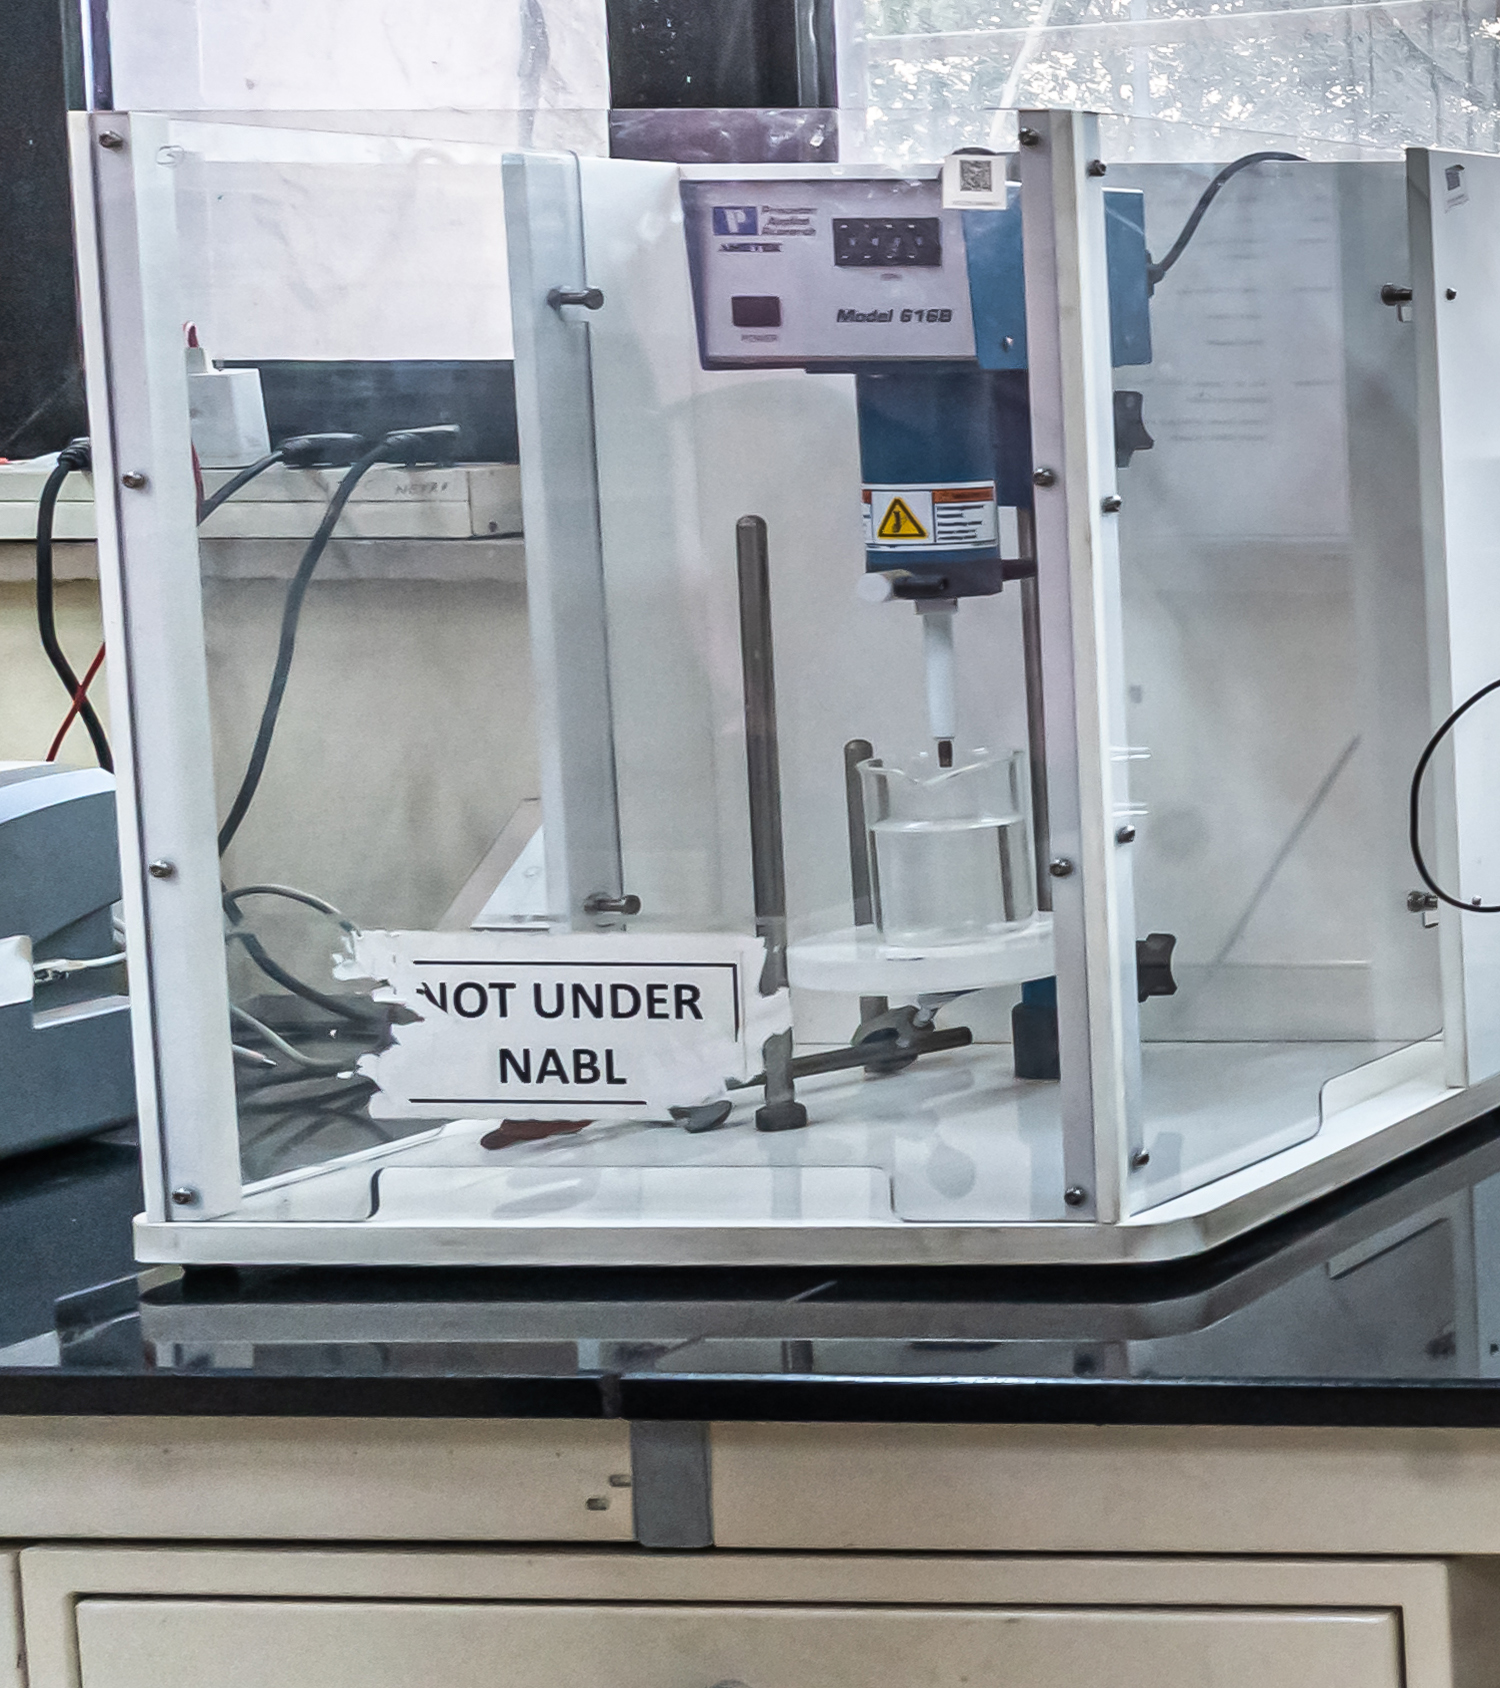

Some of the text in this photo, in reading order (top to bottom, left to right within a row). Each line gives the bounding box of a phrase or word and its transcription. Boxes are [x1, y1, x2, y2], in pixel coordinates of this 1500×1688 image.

[837, 309, 893, 322] Model
[533, 983, 703, 1020] UNDER
[500, 1048, 627, 1084] NABL
